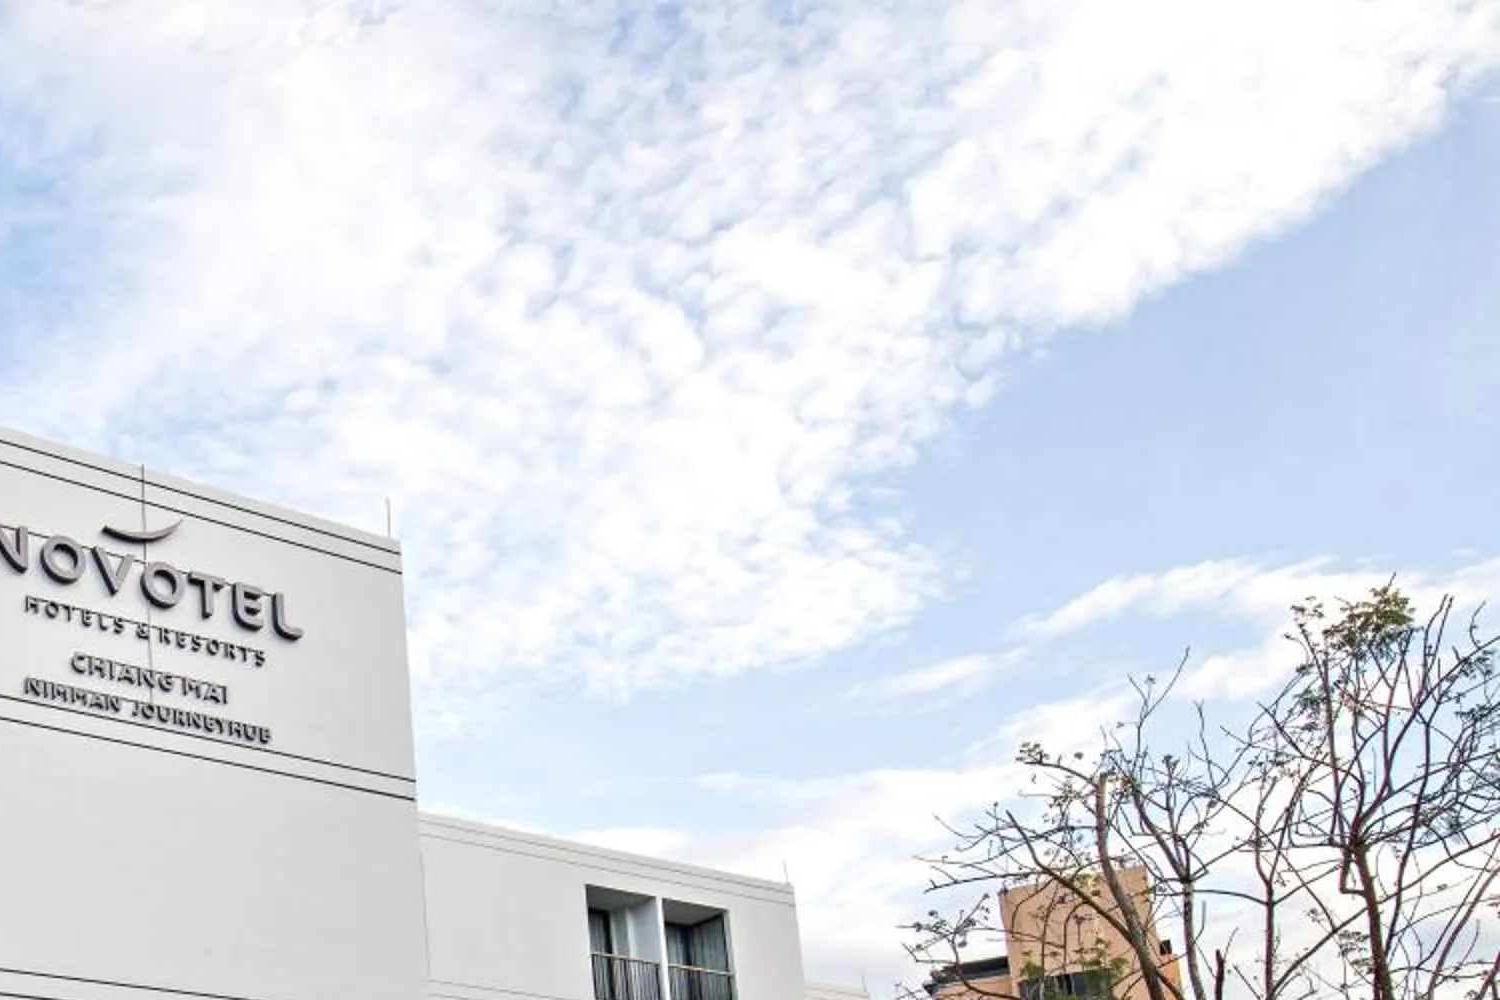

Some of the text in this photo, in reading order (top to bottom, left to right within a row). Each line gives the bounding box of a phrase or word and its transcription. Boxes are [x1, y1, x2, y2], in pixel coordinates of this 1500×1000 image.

[25, 595, 266, 667] HOTELS & RESORTS
[70, 652, 229, 705] CHIANG MAI
